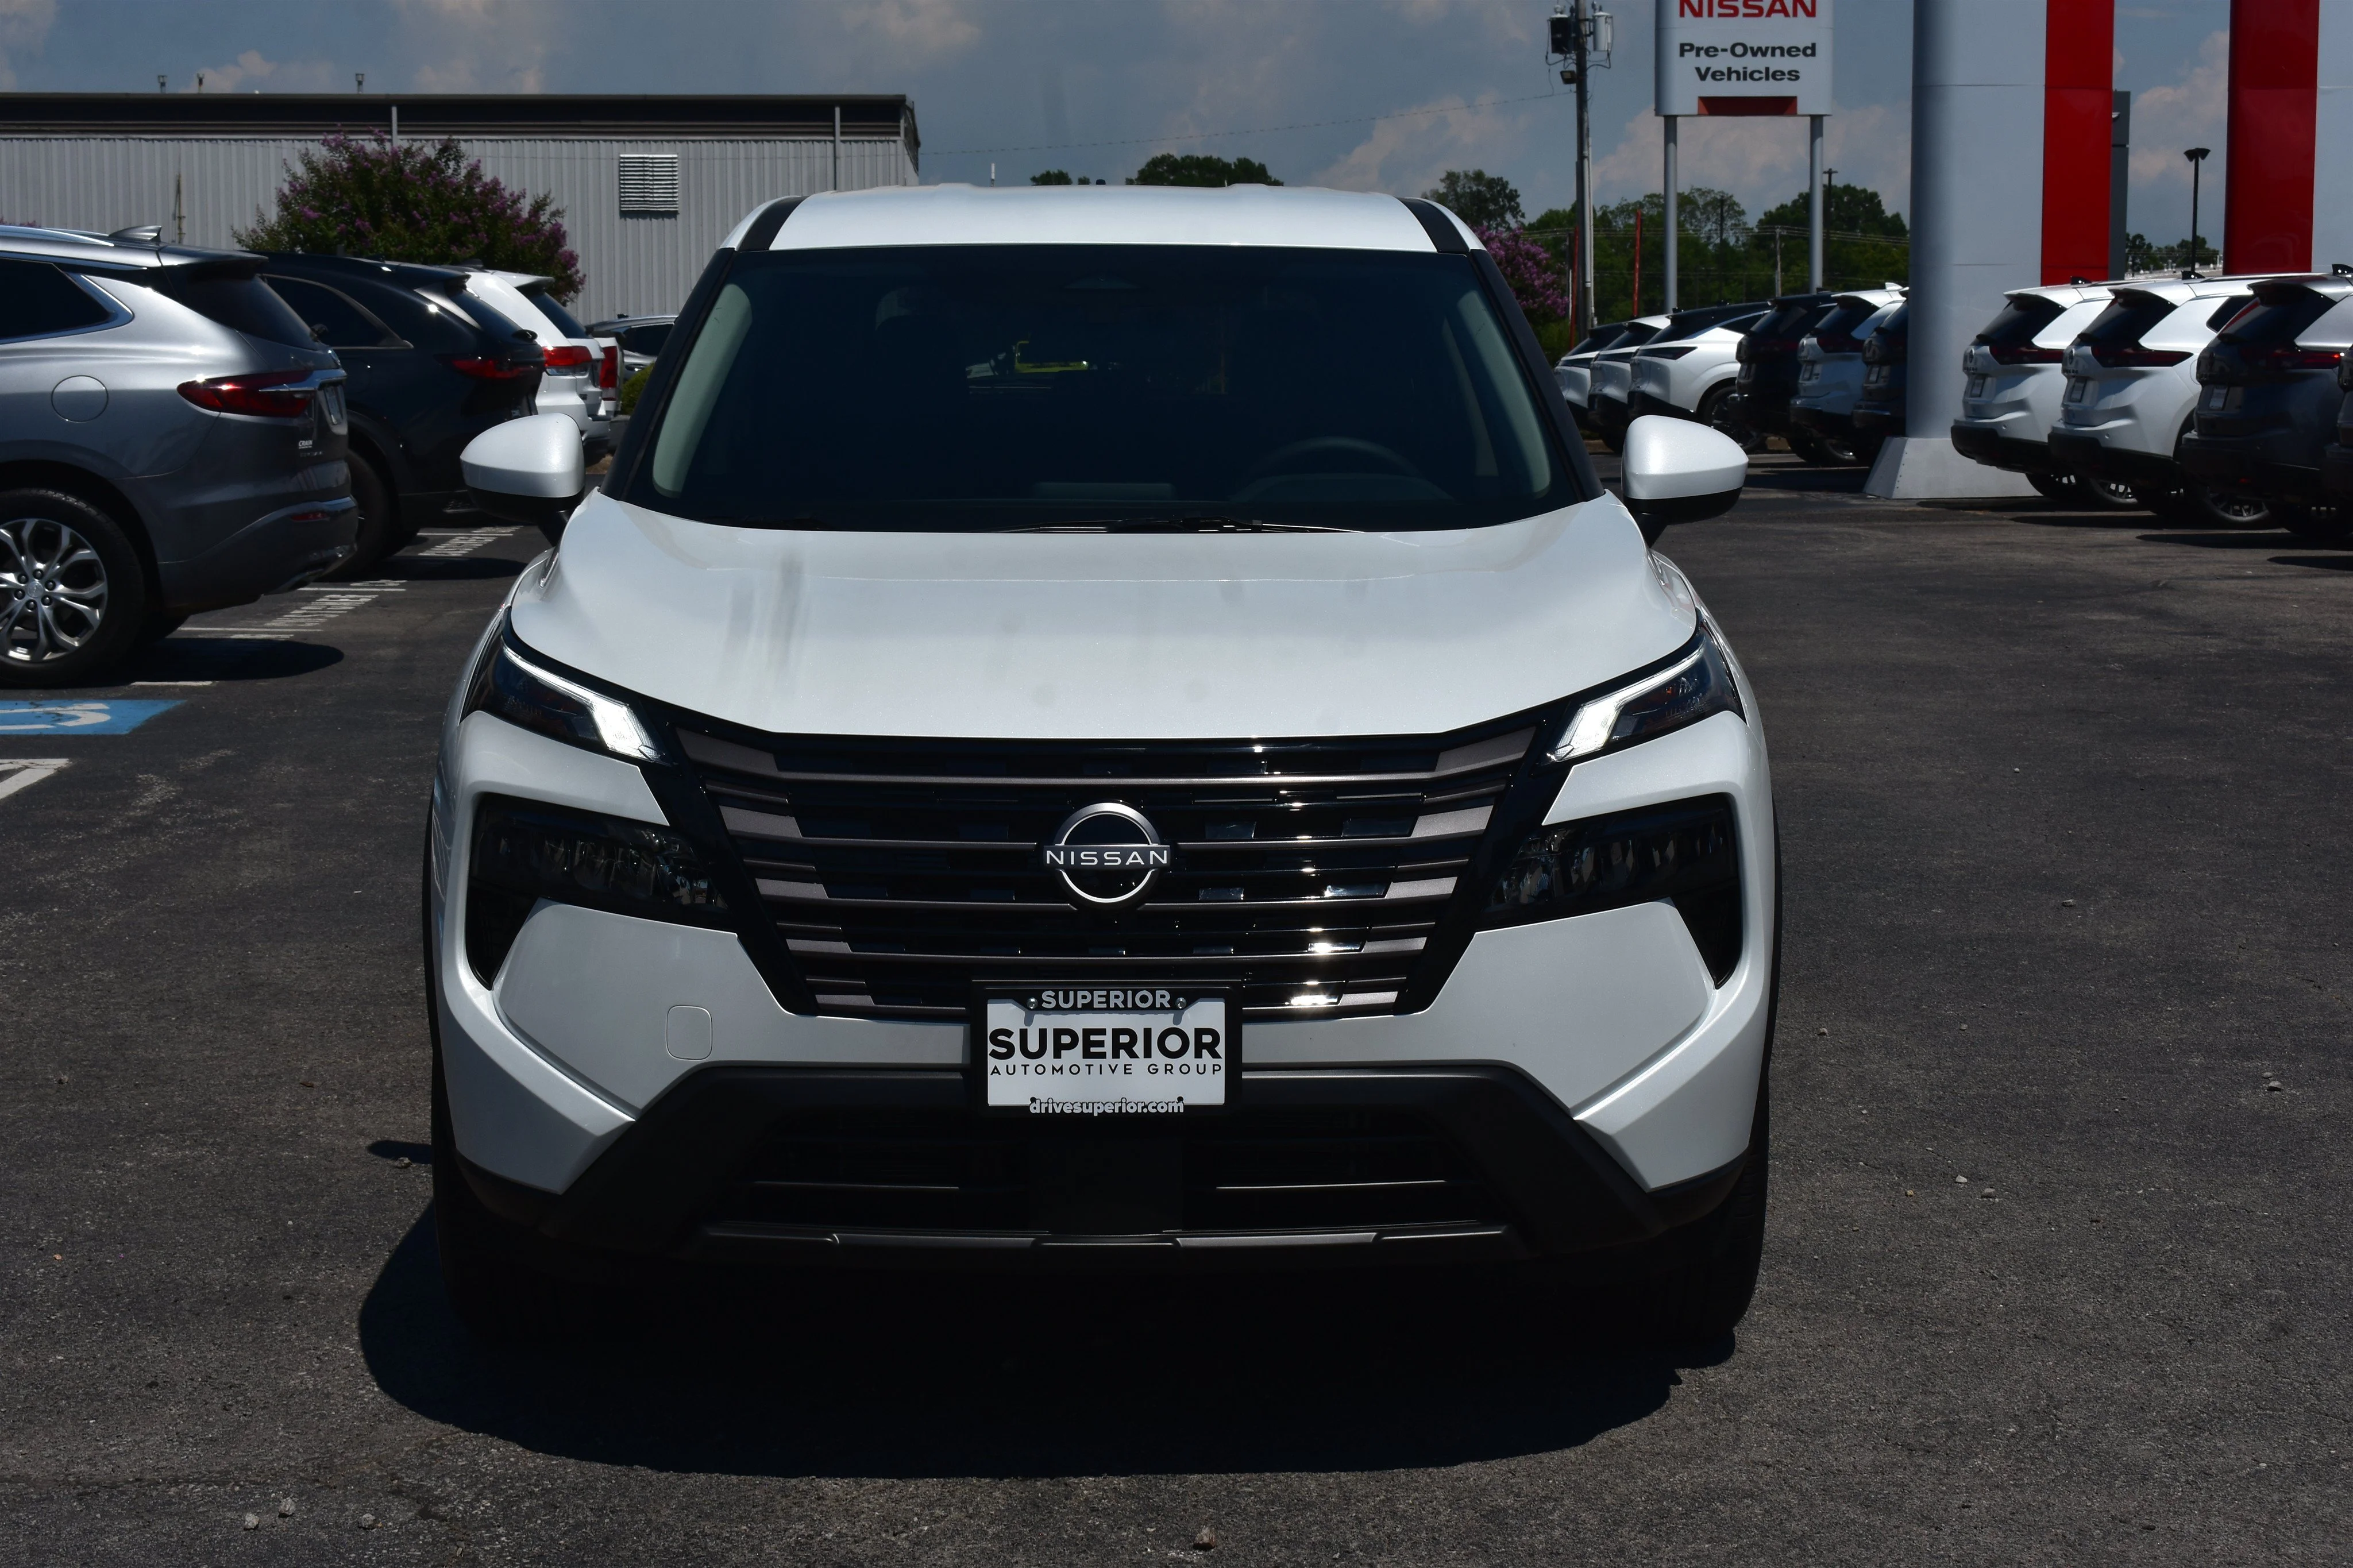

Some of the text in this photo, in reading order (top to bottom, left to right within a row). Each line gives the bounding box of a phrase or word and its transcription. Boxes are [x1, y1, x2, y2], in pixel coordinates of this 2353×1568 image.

[1679, 0, 1816, 17] NISSAN
[1679, 43, 1816, 57] Pre-Owned
[1695, 67, 1800, 81] Vehicles
[1046, 850, 1167, 866] NISSAN
[1042, 990, 1171, 1008] SUPERIOR
[989, 1027, 1222, 1060] SUPERIOR
[990, 1063, 1222, 1076] AUTOMOTIVE GROUP
[1029, 1097, 1184, 1117] drivesuperior.com
